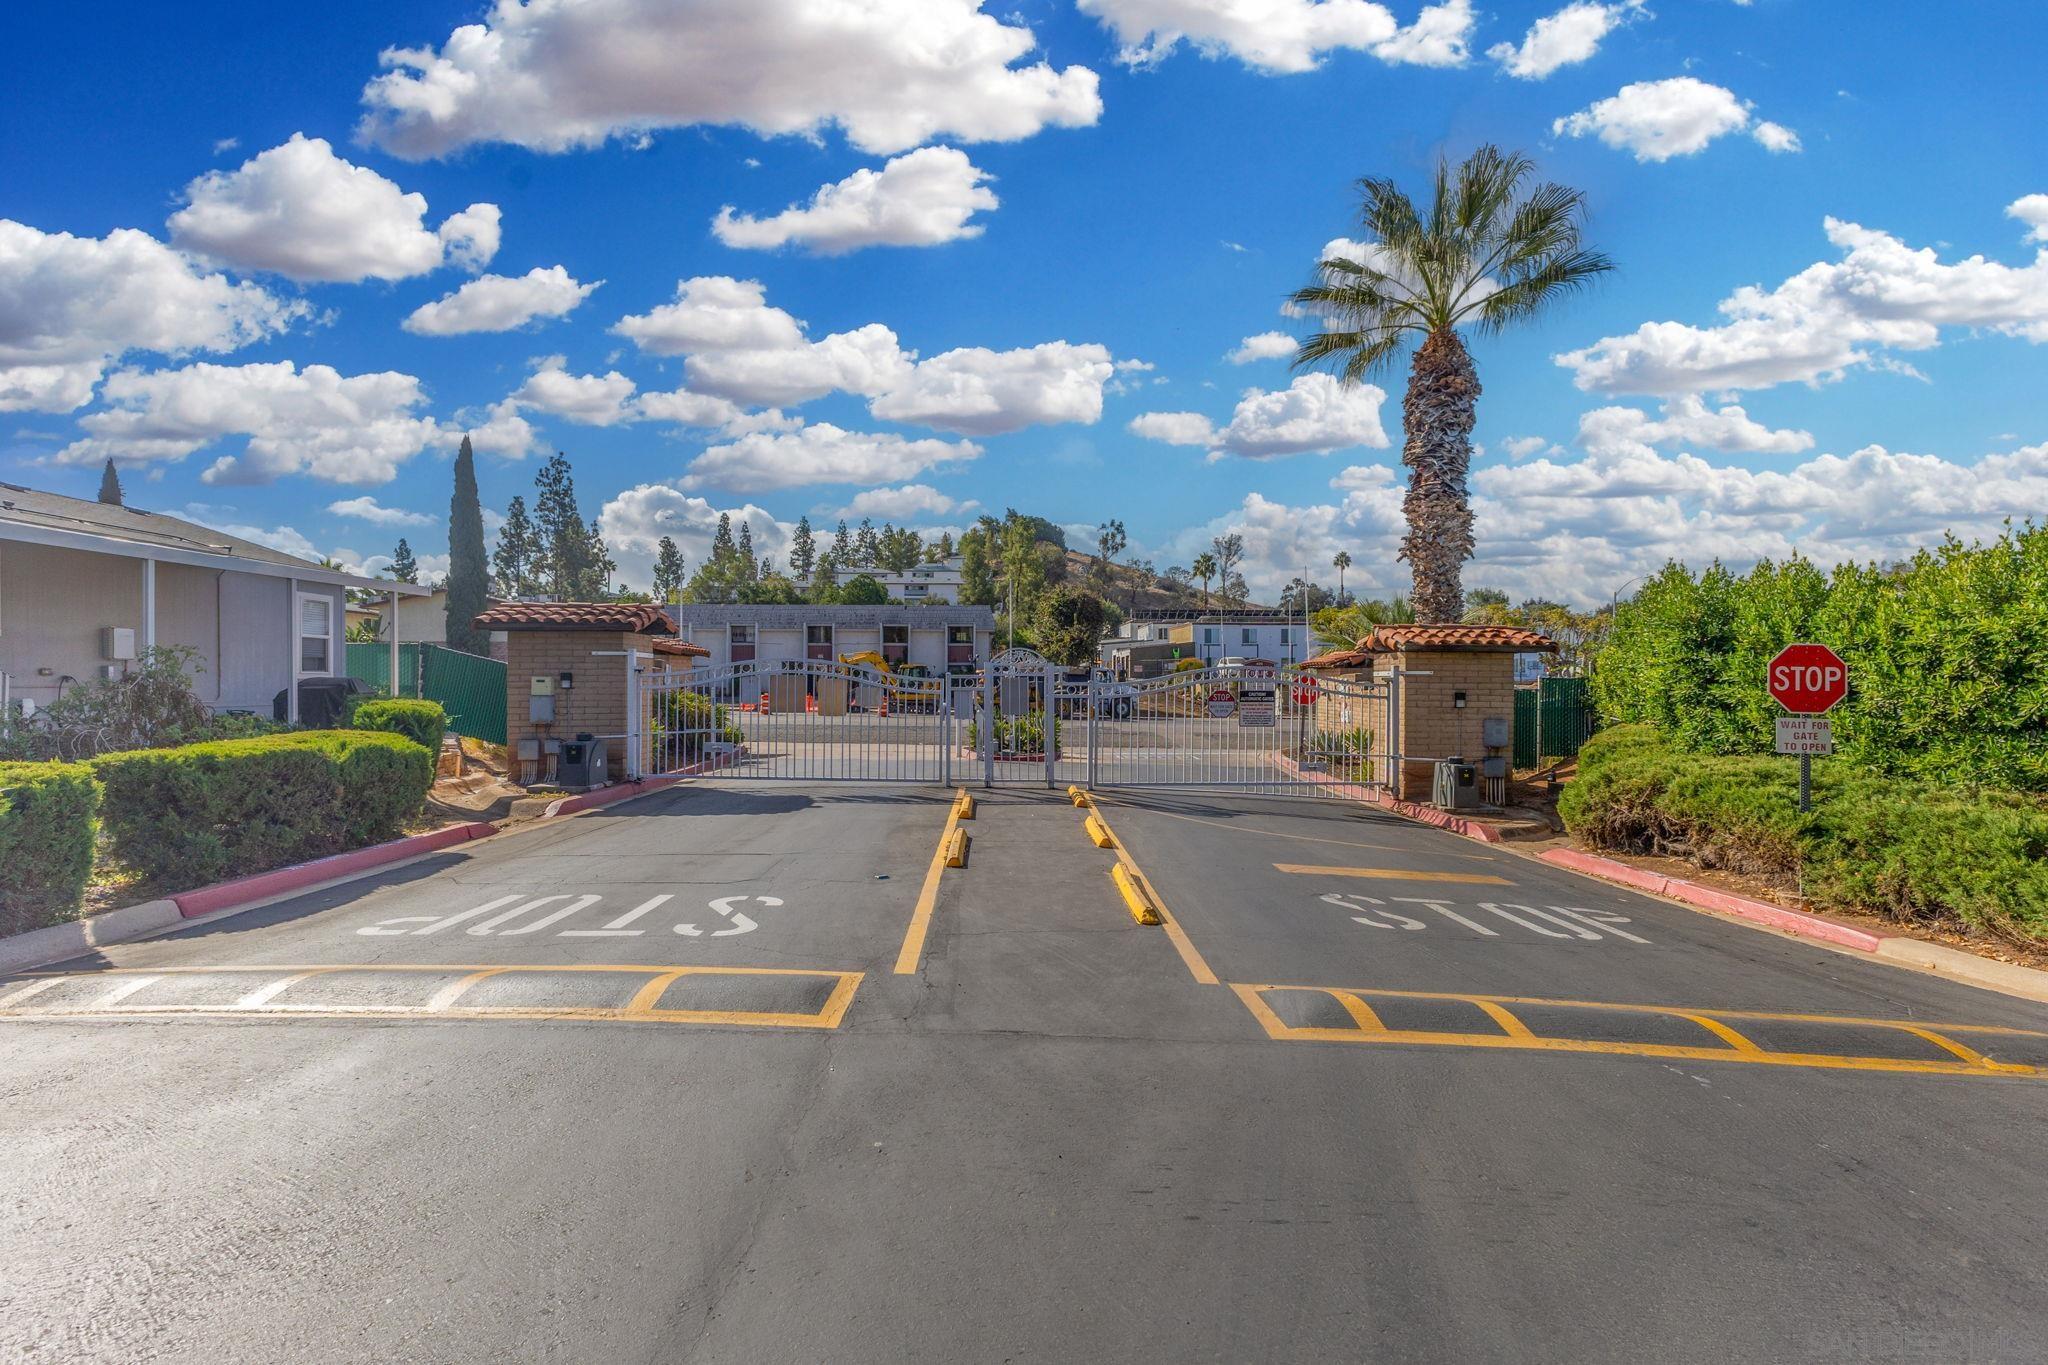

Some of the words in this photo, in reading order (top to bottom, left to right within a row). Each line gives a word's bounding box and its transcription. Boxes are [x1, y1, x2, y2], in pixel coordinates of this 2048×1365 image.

[1774, 666, 1841, 692] STOP
[1212, 693, 1231, 701] STOP
[1780, 721, 1807, 730] WAIT
[1812, 721, 1829, 730] FOR
[1793, 732, 1818, 740] GATE
[1784, 742, 1797, 751] TO
[1801, 742, 1826, 751] OPEN
[356, 894, 785, 936] STOP
[1319, 893, 1652, 944] STOP
